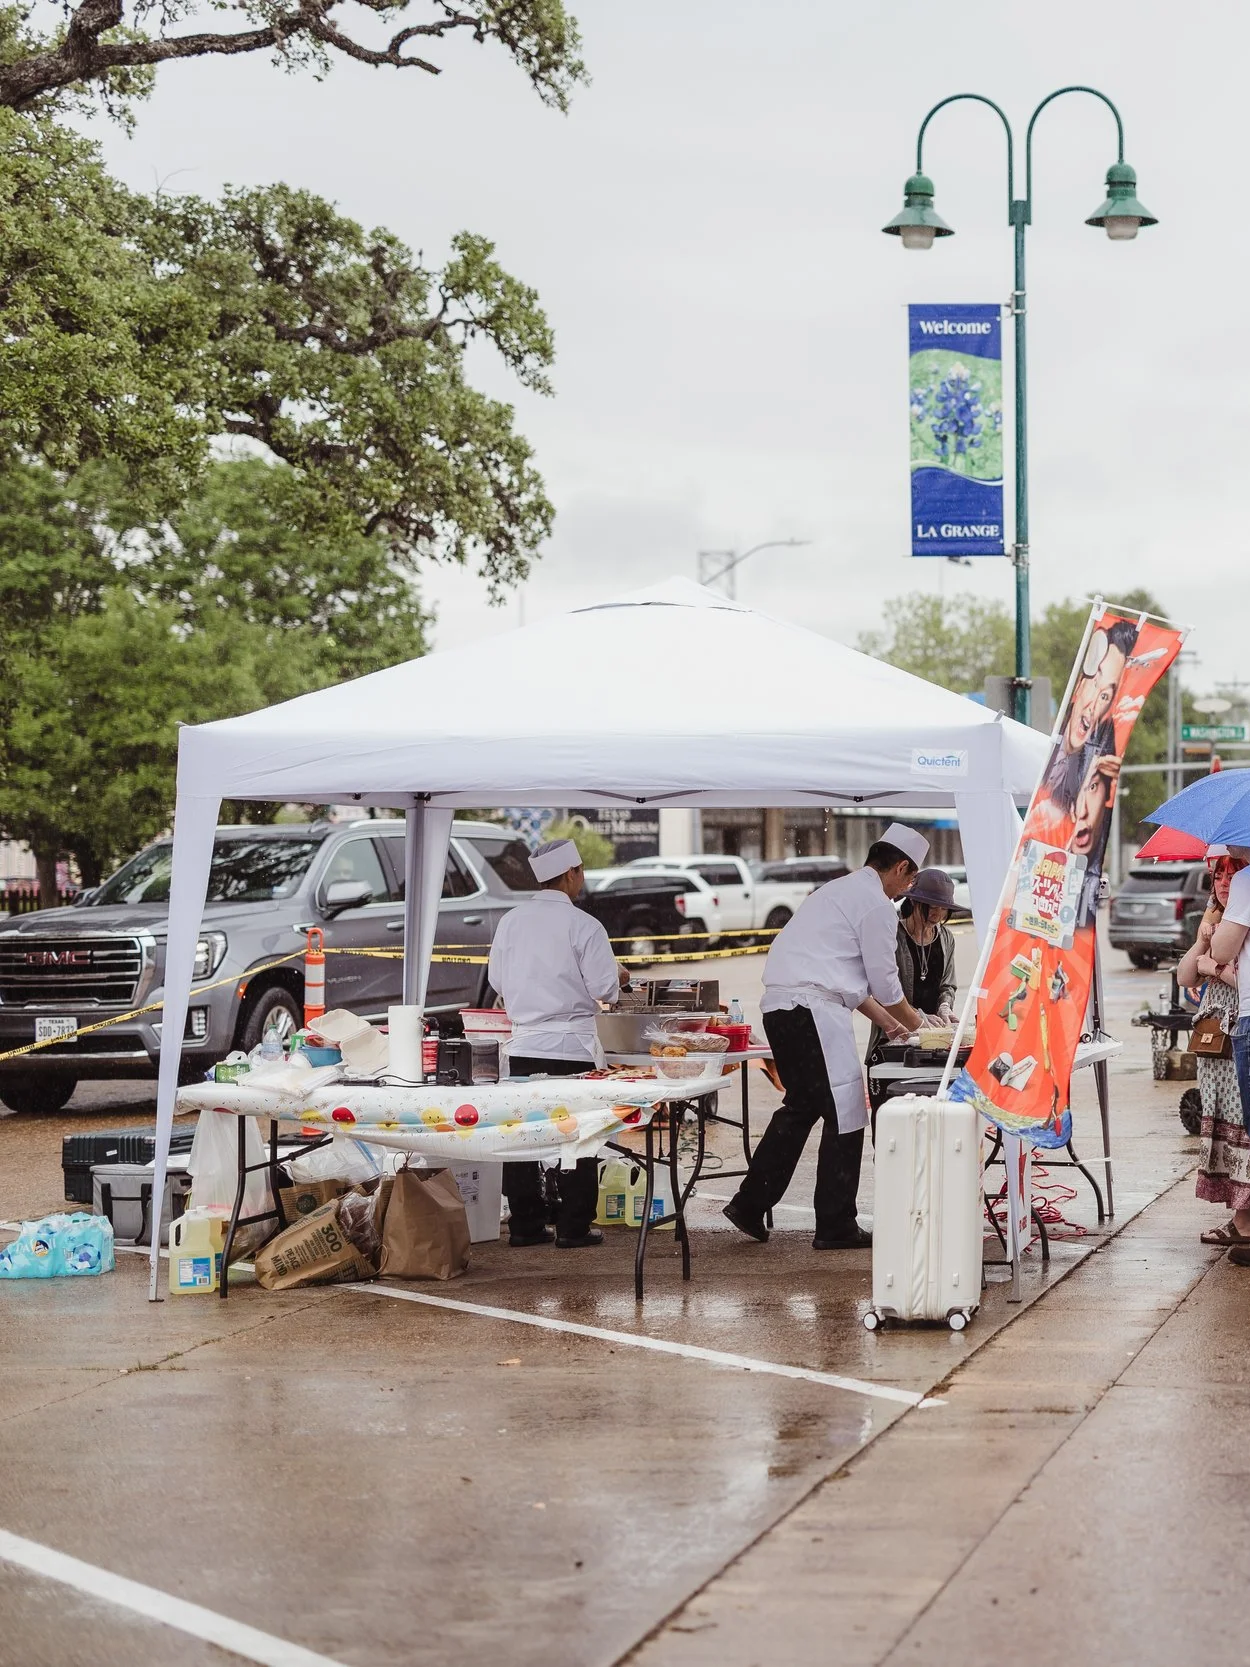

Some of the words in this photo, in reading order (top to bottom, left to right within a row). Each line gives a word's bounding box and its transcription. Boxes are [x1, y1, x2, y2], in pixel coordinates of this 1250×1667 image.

[919, 320, 991, 334] Welcome
[917, 525, 936, 538] LA
[940, 524, 999, 538] GRANGE
[917, 756, 961, 767] Quictent
[26, 950, 92, 966] GMC
[321, 1223, 342, 1252] 300
[271, 1255, 287, 1276] MIND
[285, 1248, 300, 1269] PEACE
